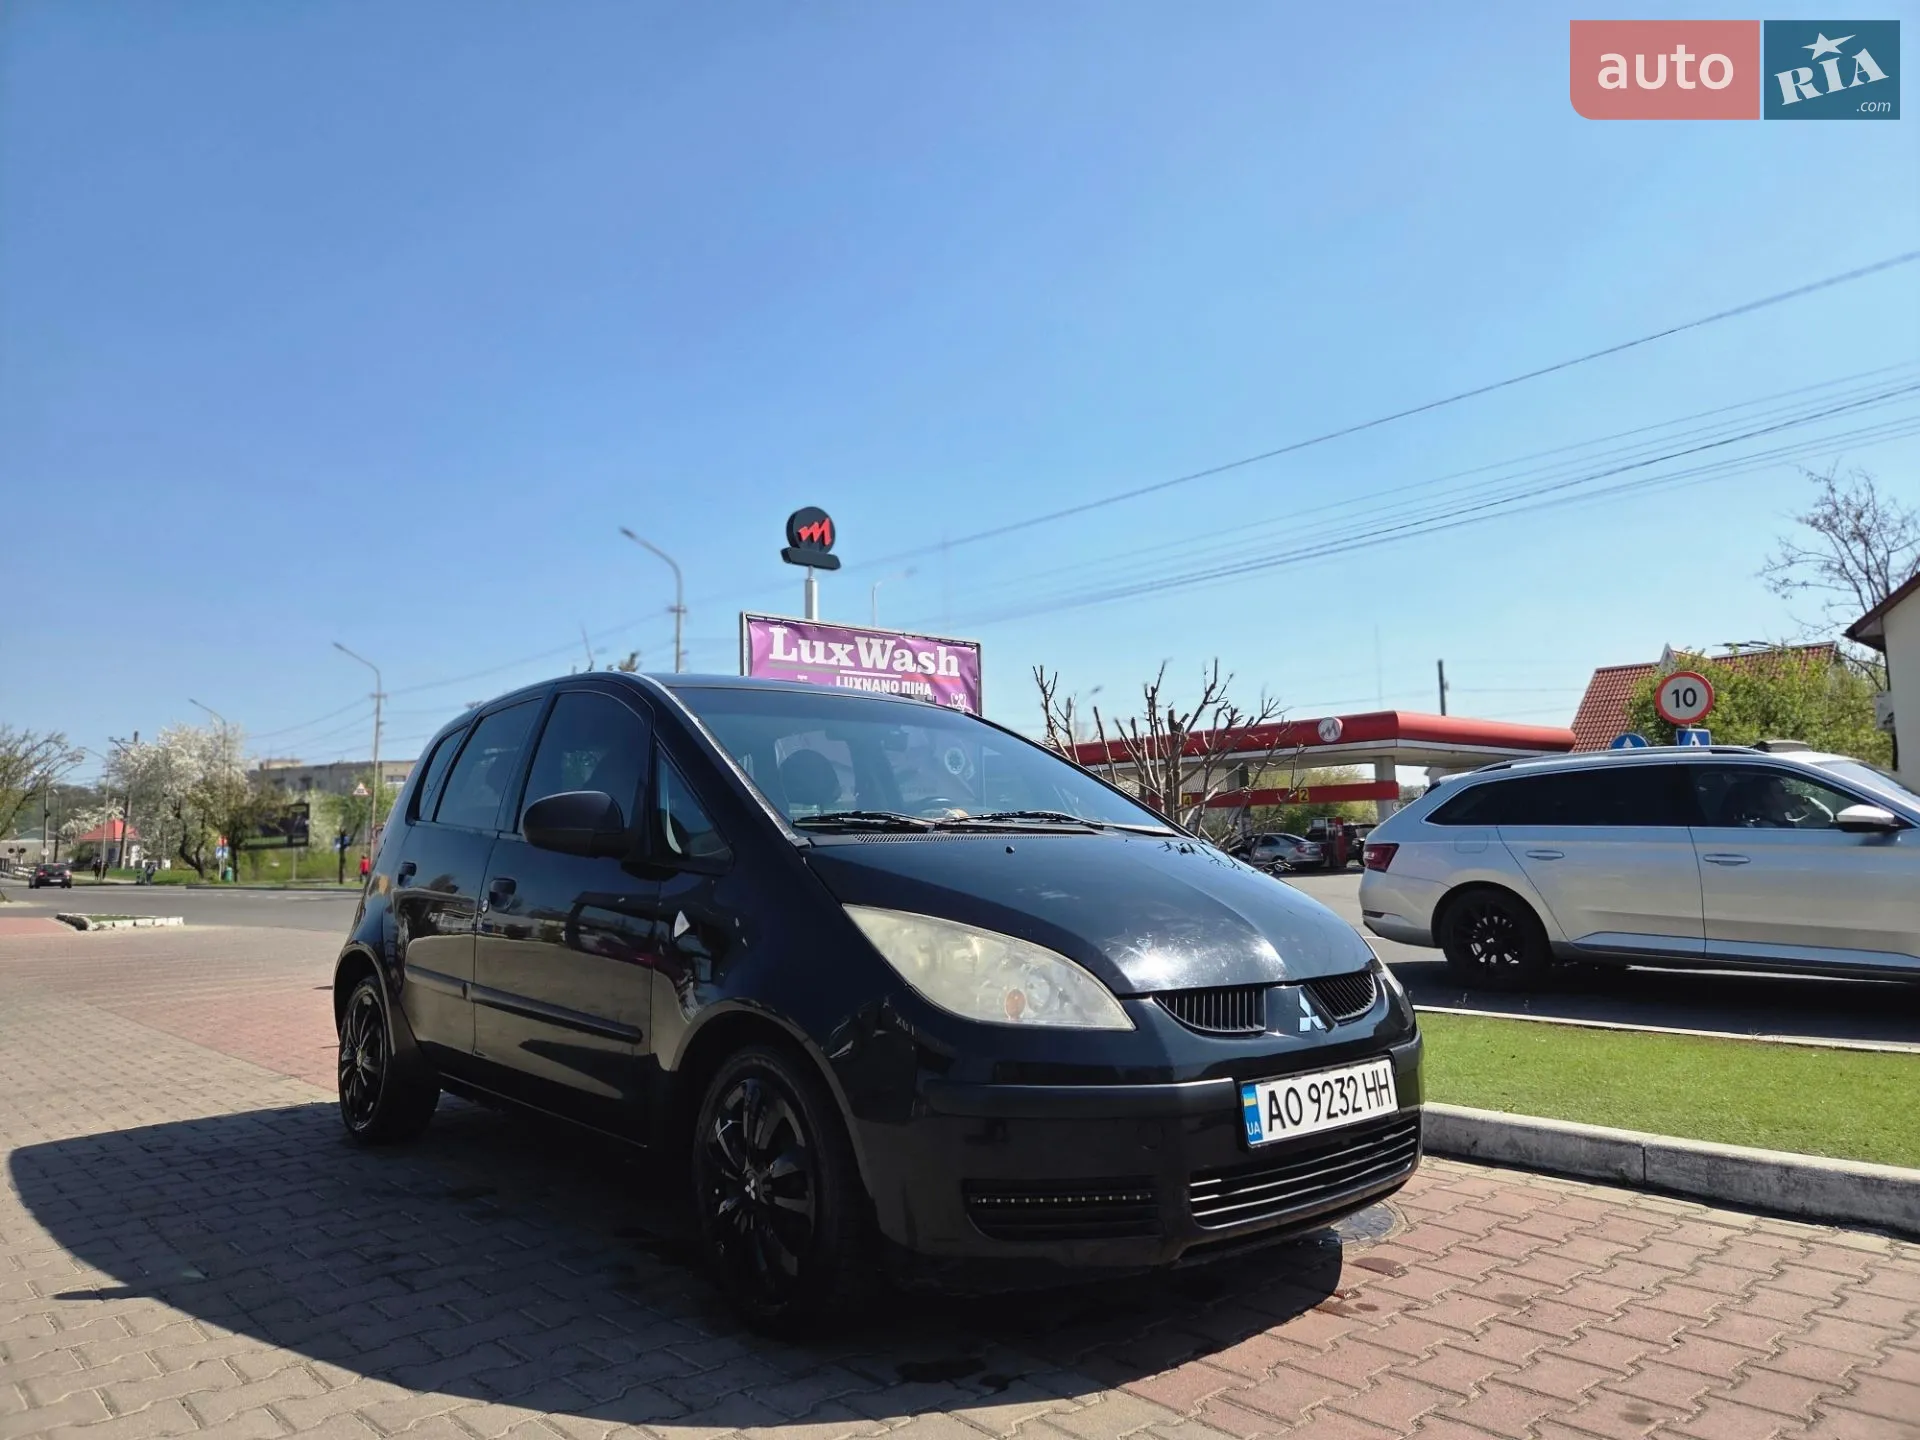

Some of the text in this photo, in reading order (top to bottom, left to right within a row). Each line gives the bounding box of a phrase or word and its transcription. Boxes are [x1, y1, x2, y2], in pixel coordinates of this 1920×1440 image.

[768, 627, 960, 677] LuxWash
[1672, 687, 1697, 708] 10
[1299, 789, 1308, 801] 2
[1268, 1067, 1392, 1132] AO 9232 HH
[1247, 1121, 1262, 1136] UA
